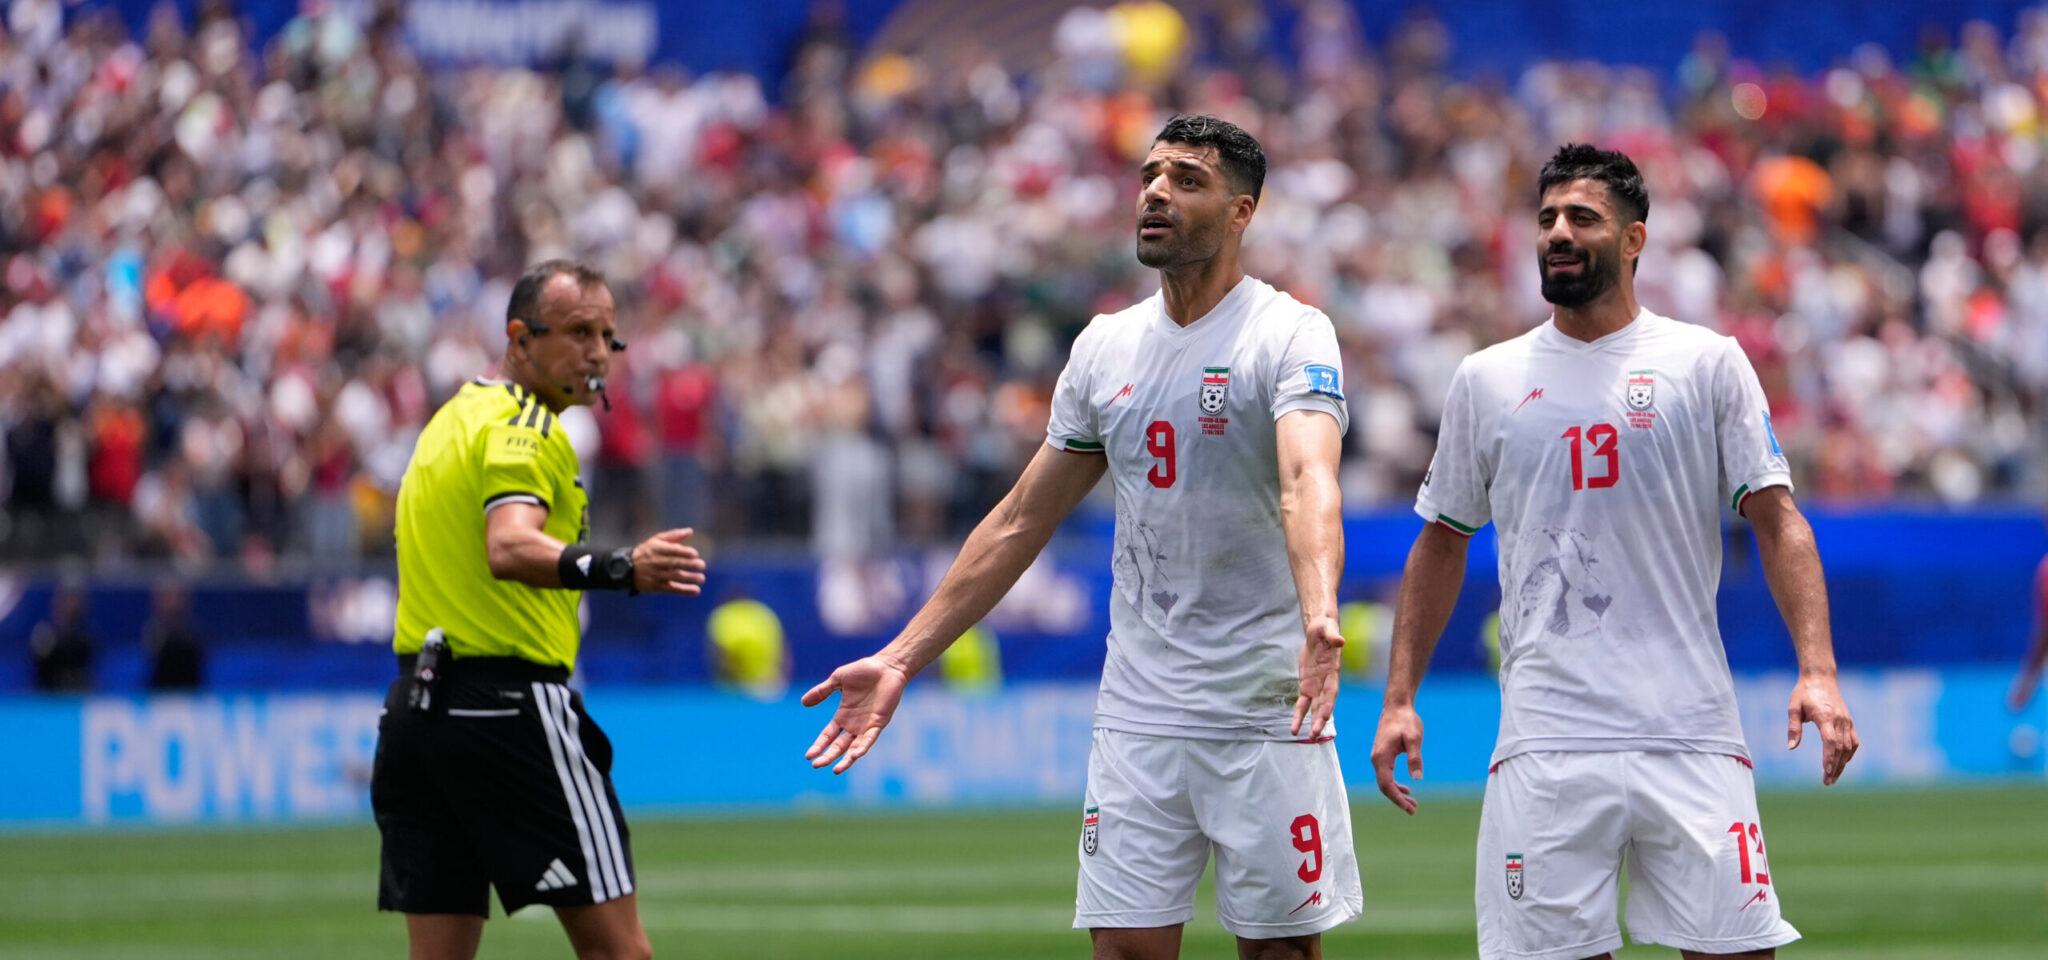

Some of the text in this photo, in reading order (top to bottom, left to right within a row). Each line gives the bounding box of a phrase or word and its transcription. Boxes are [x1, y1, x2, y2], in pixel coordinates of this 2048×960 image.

[506, 436, 539, 451] FIFA
[1146, 420, 1176, 489] 9
[1561, 423, 1619, 491] 13
[1290, 813, 1322, 884] 9
[1728, 822, 1770, 886] 13
